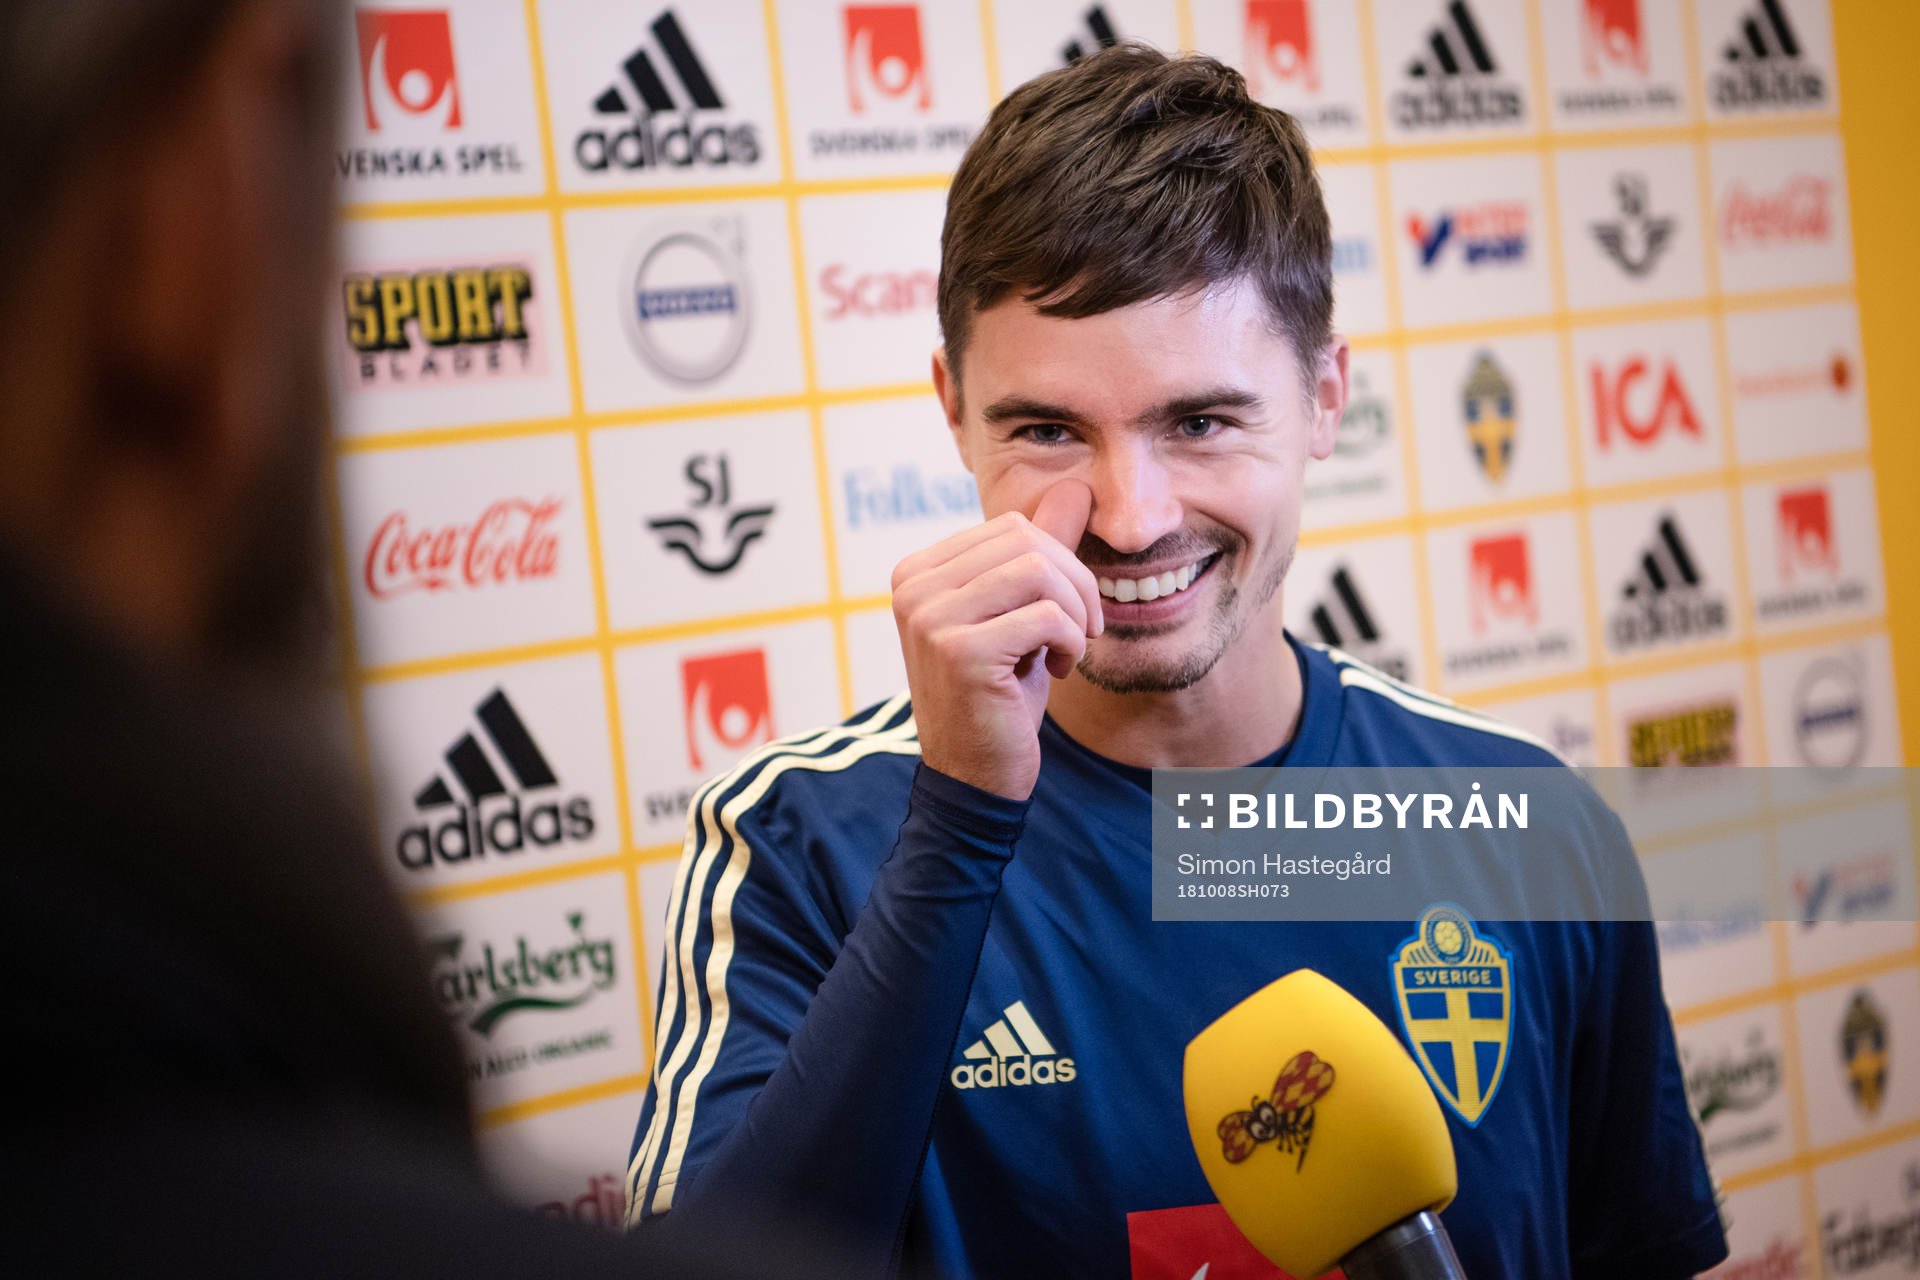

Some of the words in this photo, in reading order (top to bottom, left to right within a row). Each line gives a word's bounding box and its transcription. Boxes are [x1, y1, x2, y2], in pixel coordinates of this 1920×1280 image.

[335, 147, 446, 180] VENSKA
[456, 141, 523, 174] SPEL
[574, 110, 762, 172] adidas
[344, 266, 533, 354] SPORT
[818, 261, 939, 321] Scan
[359, 341, 530, 382] BLADET
[1588, 352, 1704, 453] ICA
[683, 450, 731, 510] SJ
[842, 463, 980, 530] Folksa
[396, 796, 596, 873] adidas
[645, 788, 694, 823] SVE
[1414, 969, 1491, 986] SVERIGE
[951, 1054, 1077, 1089] adidas
